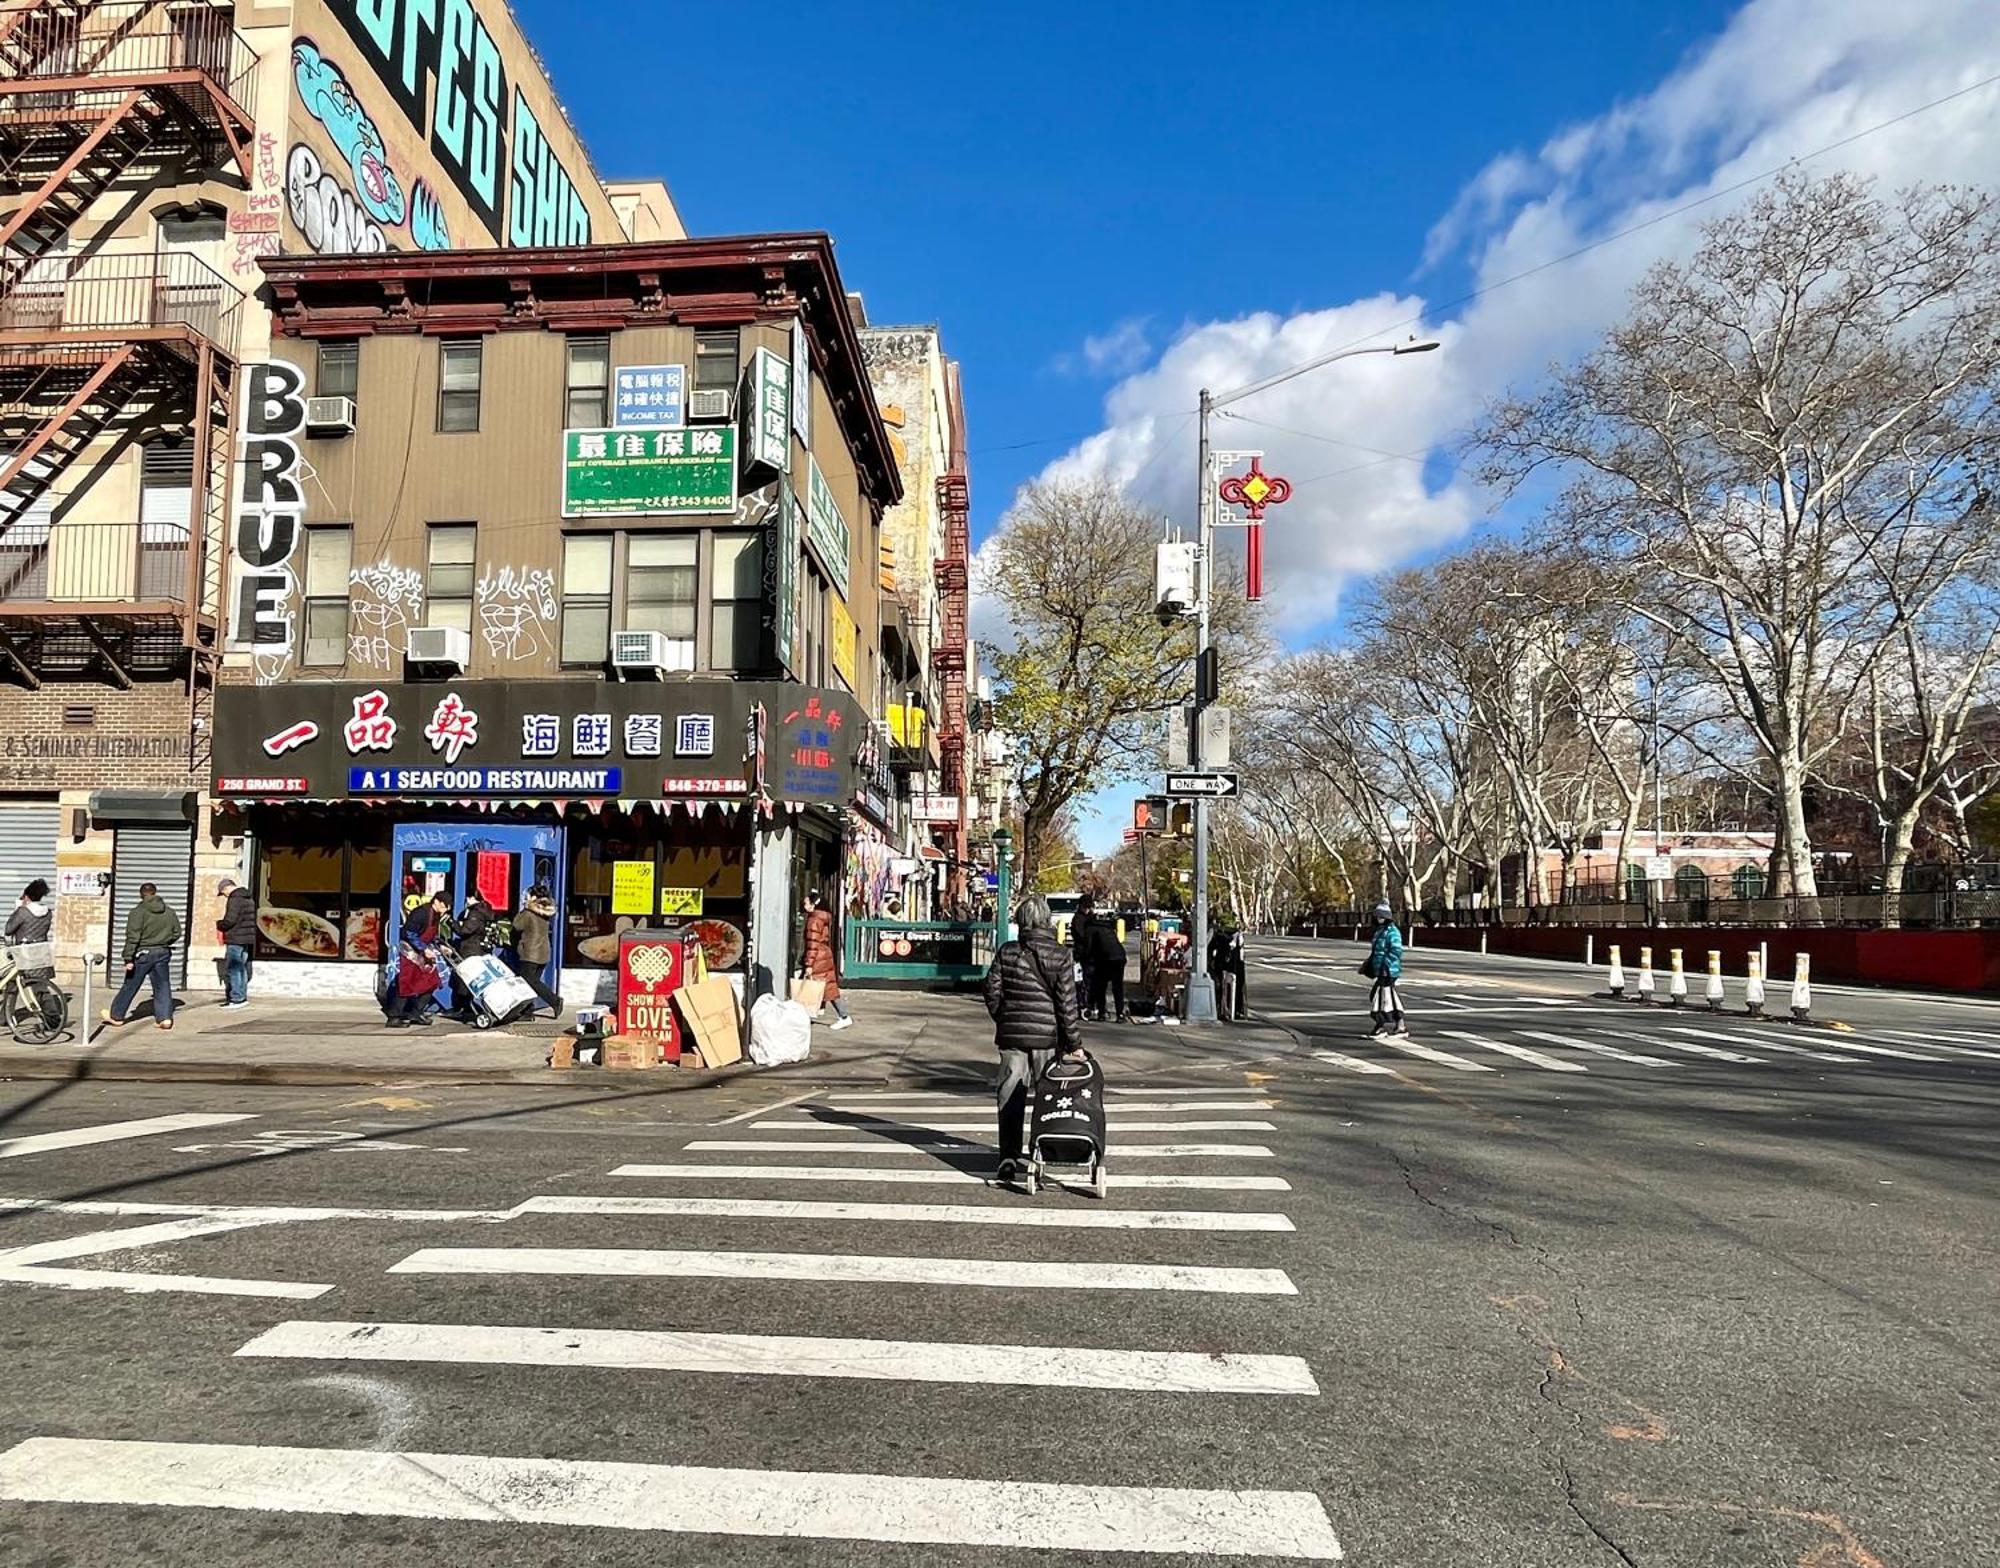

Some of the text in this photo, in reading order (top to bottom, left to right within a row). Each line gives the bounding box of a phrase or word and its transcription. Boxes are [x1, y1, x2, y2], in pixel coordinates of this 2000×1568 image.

[621, 411, 674, 421] INCOME TAX
[577, 431, 723, 458] 最佳保險
[232, 361, 307, 655] BRUE
[263, 690, 478, 764] 一品軒
[523, 714, 714, 755] 海鮮餐廳
[5, 736, 18, 757] &
[22, 735, 91, 757] SEMINARY
[223, 779, 244, 791] 250
[246, 779, 285, 791] GRAND
[362, 770, 608, 789] A 1 SEAFOOD RESTAURANT
[1175, 780, 1227, 789] ONE WAY
[879, 931, 965, 941] Grand Street Station
[627, 994, 654, 1006] SHOW
[626, 1007, 672, 1029] LOVE
[1041, 1110, 1073, 1122] COOLER
